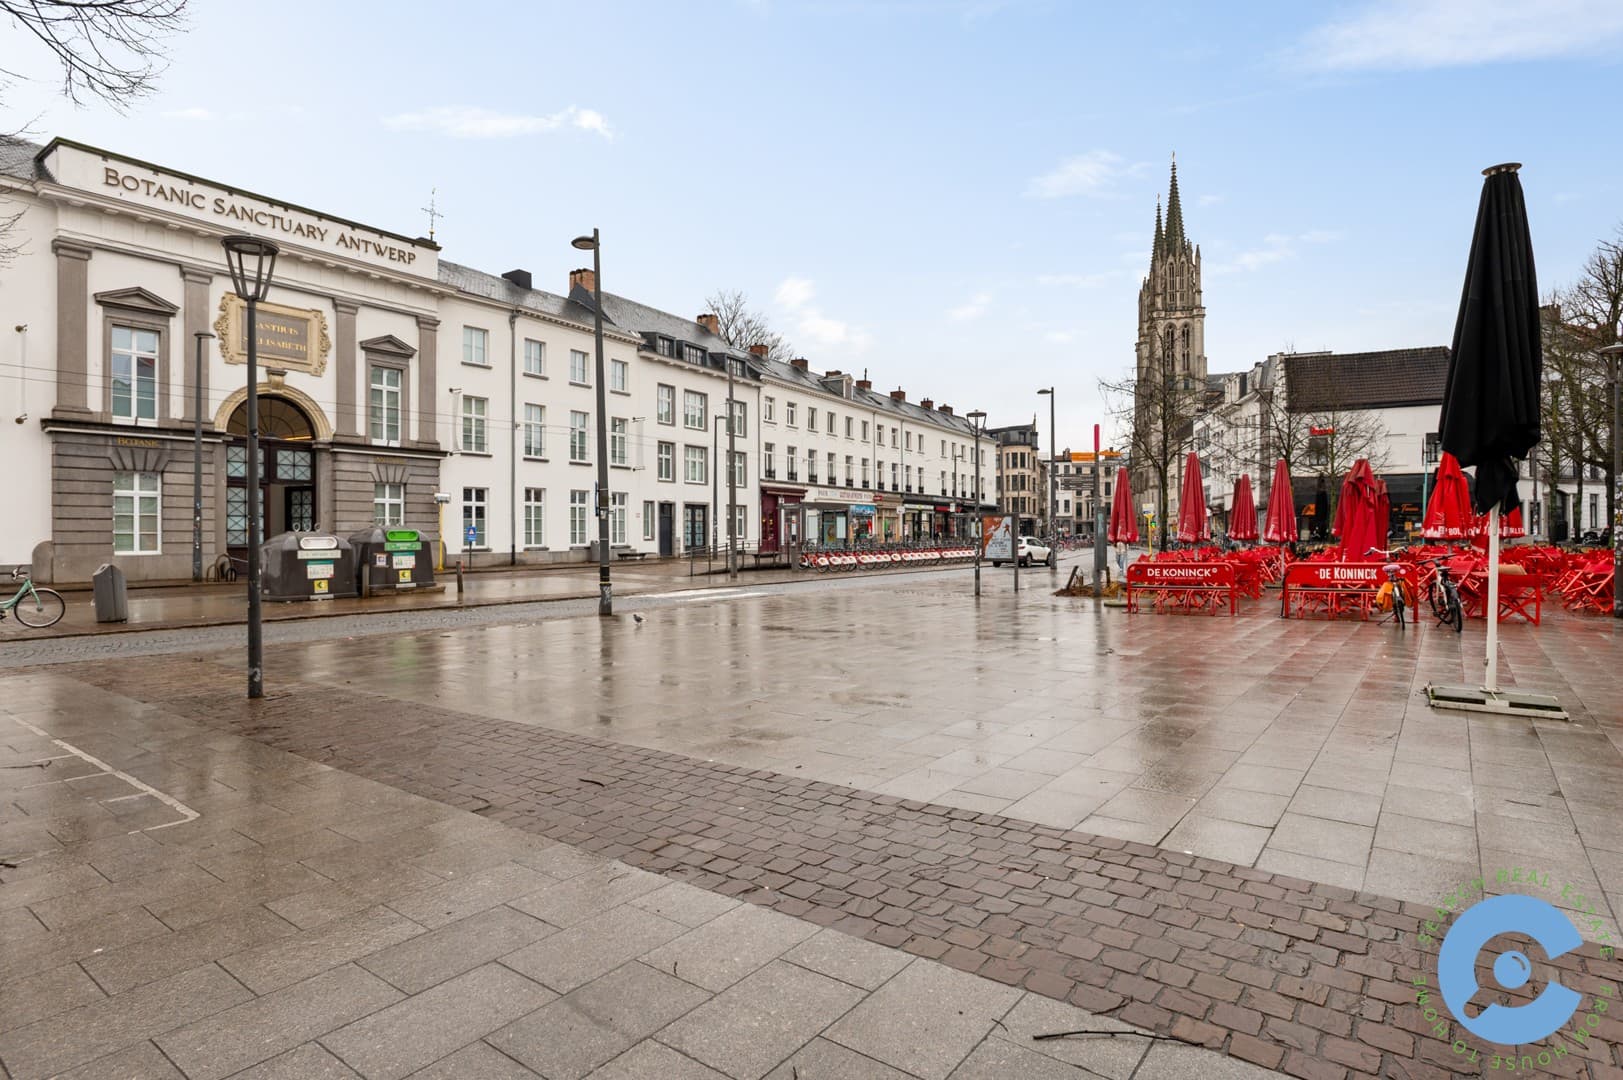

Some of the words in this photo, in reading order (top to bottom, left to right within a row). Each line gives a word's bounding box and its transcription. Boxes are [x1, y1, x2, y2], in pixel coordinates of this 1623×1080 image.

[104, 167, 205, 209] BOTANIC
[213, 198, 328, 241] SANCTUARY
[336, 232, 416, 265] ANTWERP
[255, 322, 299, 336] ASTHUIS
[1147, 568, 1160, 577] DE
[1162, 568, 1211, 577] KONINCK
[1319, 568, 1331, 579] DE
[1334, 567, 1377, 579] KONINCK
